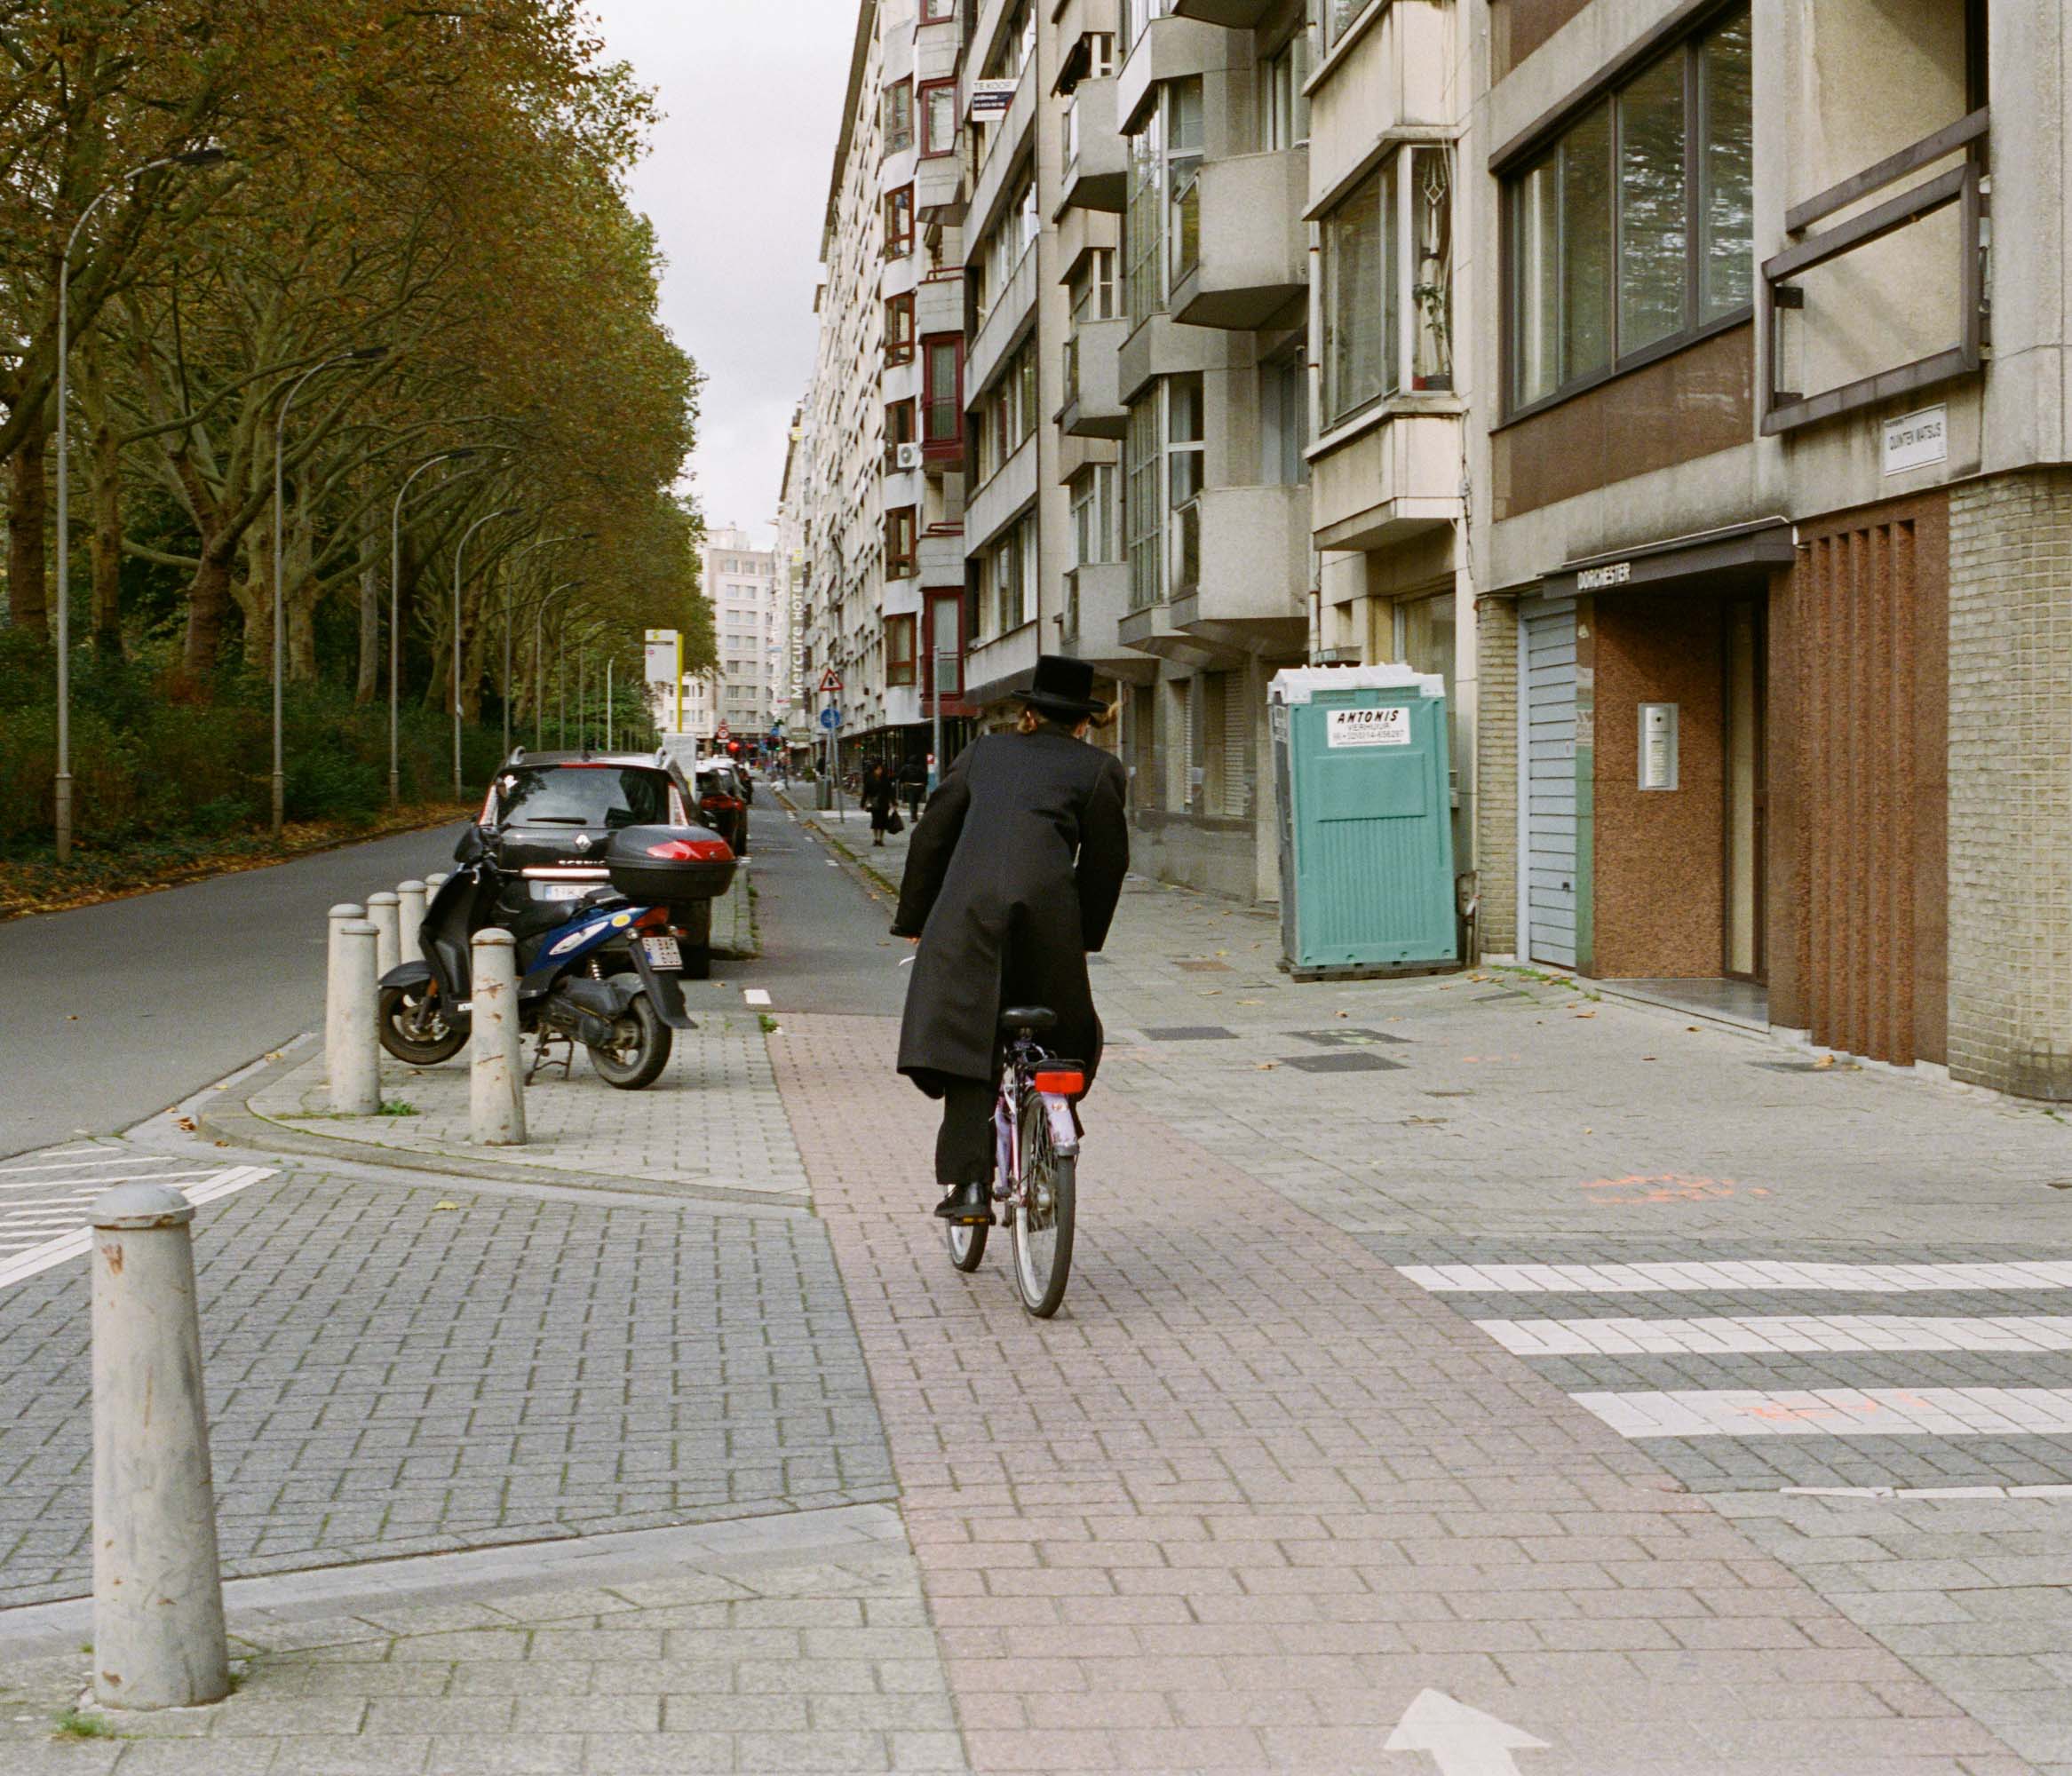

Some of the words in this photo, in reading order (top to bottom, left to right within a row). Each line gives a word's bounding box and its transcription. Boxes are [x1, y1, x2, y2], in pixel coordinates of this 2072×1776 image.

[791, 577, 804, 621] HOTEL
[790, 626, 804, 700] Mercure
[1337, 710, 1400, 725] ANTONIS
